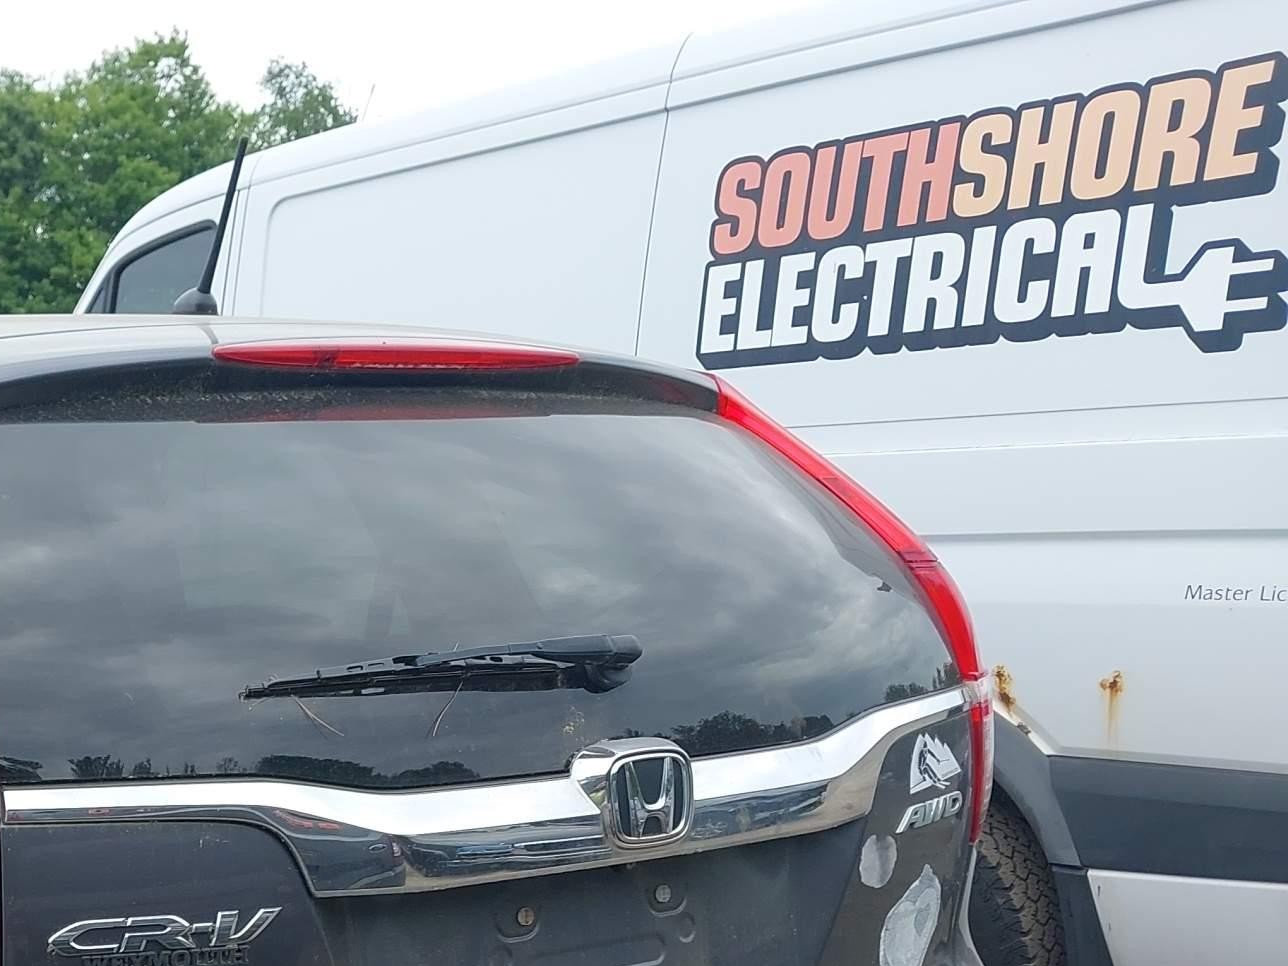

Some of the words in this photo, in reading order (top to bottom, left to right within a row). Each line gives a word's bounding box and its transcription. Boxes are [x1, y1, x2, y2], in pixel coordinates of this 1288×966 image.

[711, 56, 1278, 257] SOUTHSHORE
[698, 202, 1188, 355] ELECTRICAL
[1184, 584, 1254, 601] Master
[896, 791, 963, 834] AWD
[47, 906, 283, 956] CR-V
